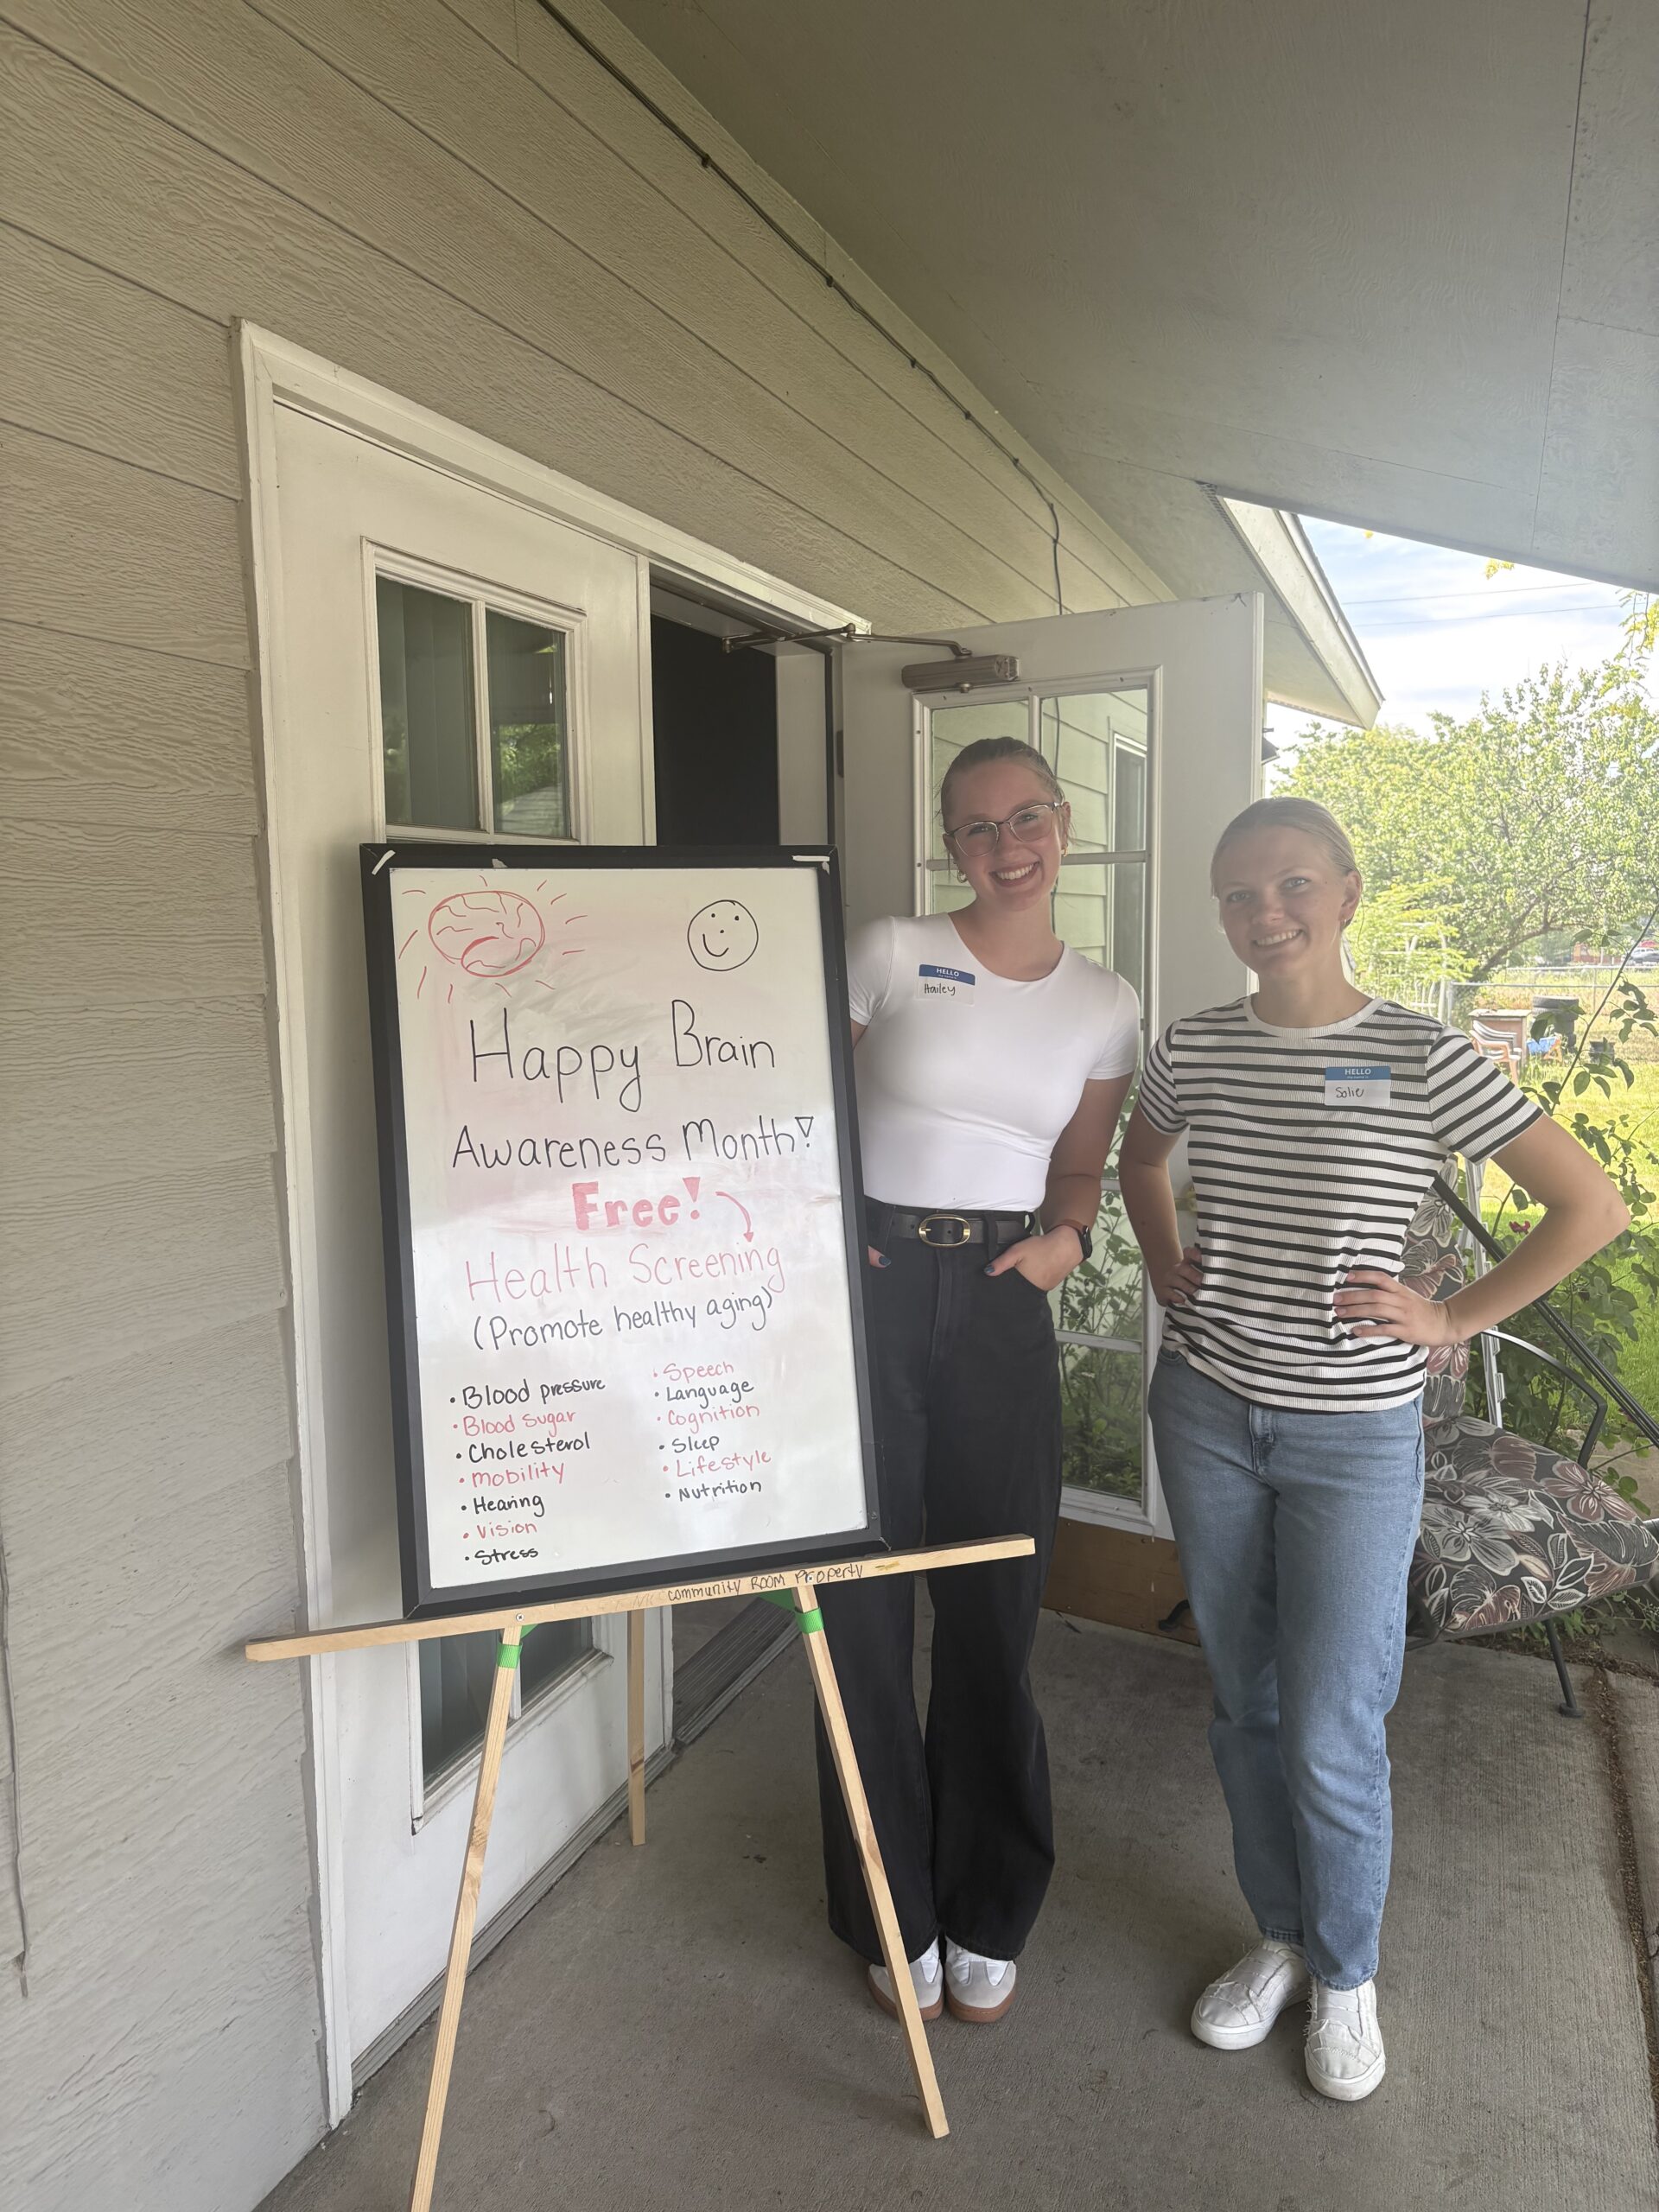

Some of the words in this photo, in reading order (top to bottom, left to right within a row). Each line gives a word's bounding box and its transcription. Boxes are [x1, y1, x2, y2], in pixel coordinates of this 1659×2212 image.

[937, 968, 959, 976] HELLO
[468, 1007, 641, 1112] Happy
[672, 1000, 775, 1069] Brain
[452, 1125, 666, 1169] Awareness
[572, 1177, 701, 1231] Free!
[466, 1243, 608, 1303] Health
[629, 1242, 785, 1294] Screening
[474, 1308, 603, 1351] (Promote
[613, 1300, 696, 1332] healthy
[705, 1286, 772, 1332] aging)
[663, 1361, 734, 1383] Speech
[462, 1378, 530, 1409] Blood
[666, 1381, 754, 1409] Language
[463, 1414, 516, 1437] Blood
[668, 1403, 760, 1434] Cognition
[468, 1431, 590, 1463] Cholesterol
[671, 1435, 721, 1453] Sleep
[677, 1450, 772, 1478] Lifestyle
[678, 1480, 762, 1503] Nutrition
[474, 1495, 545, 1517] Hearing
[474, 1548, 539, 1566] Stress
